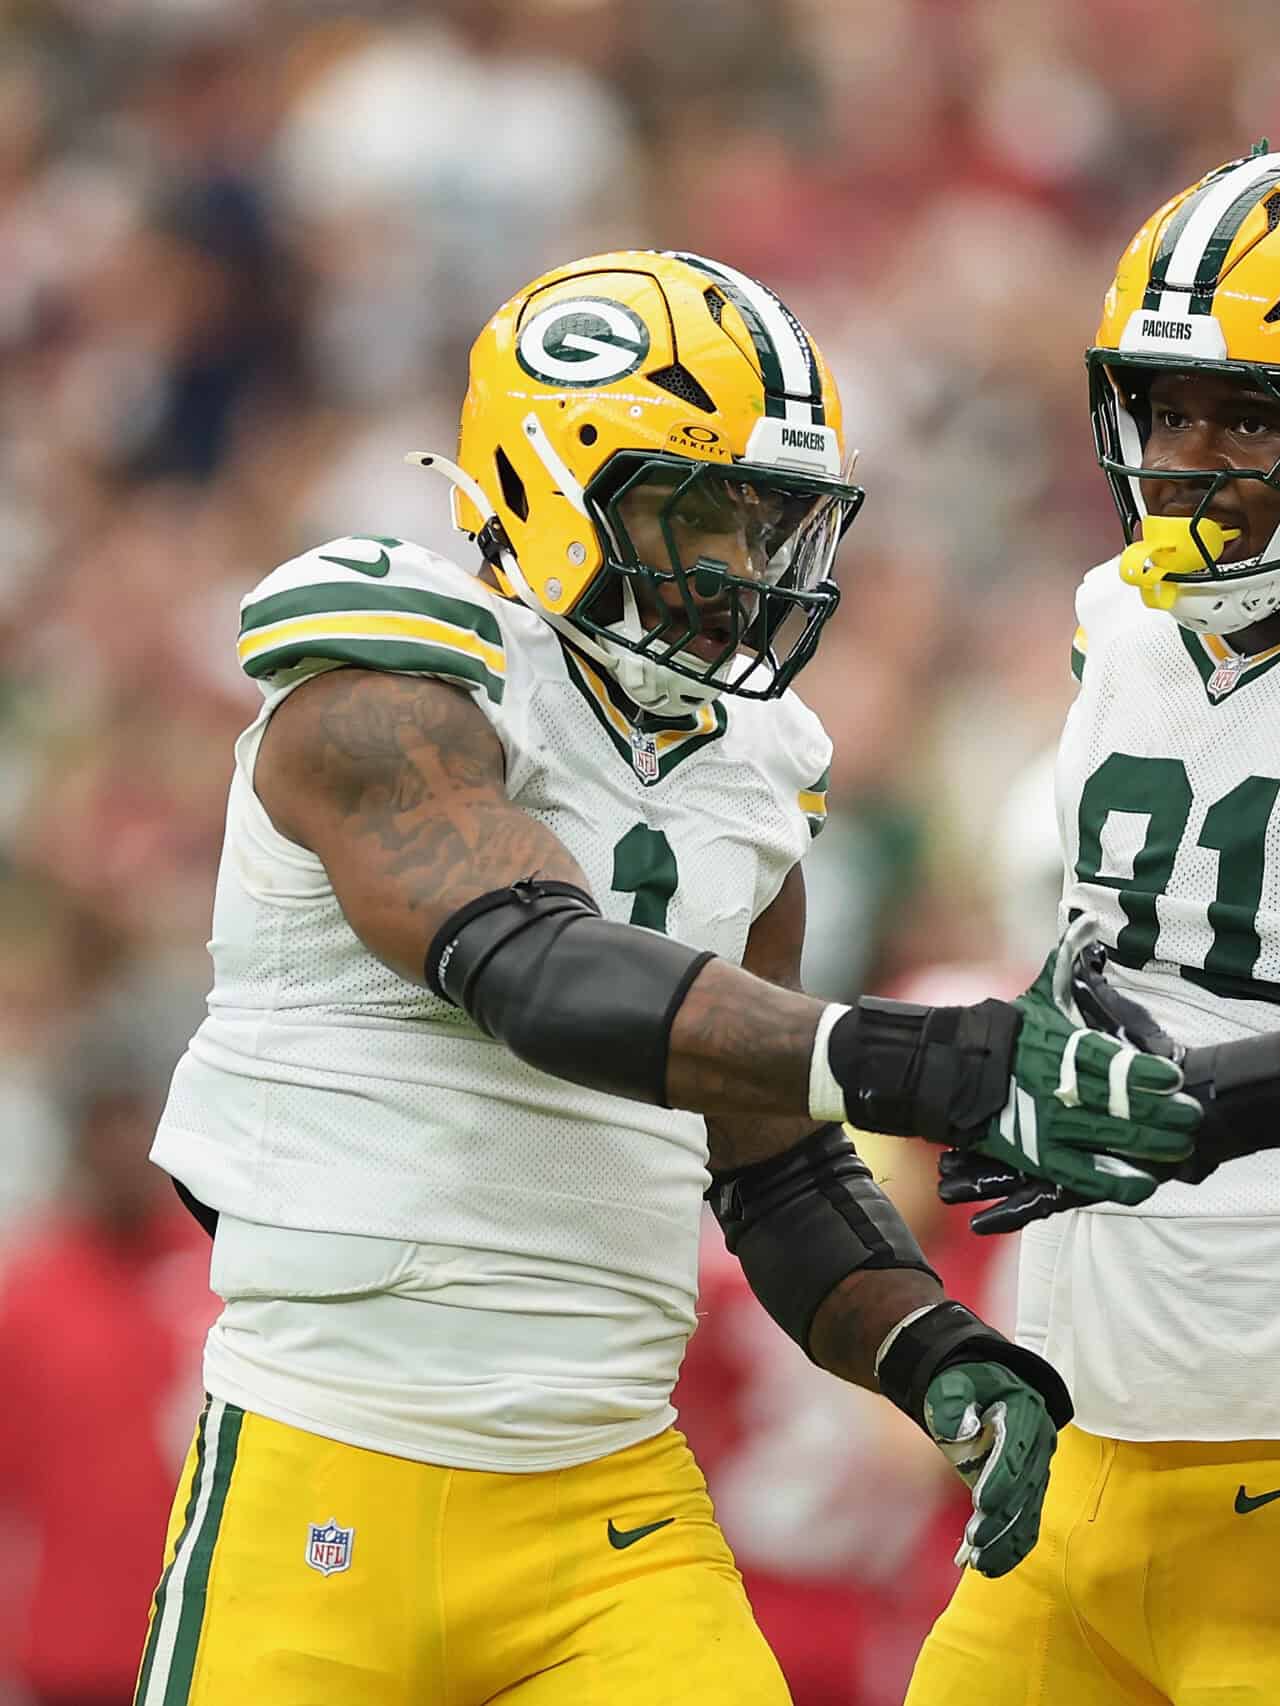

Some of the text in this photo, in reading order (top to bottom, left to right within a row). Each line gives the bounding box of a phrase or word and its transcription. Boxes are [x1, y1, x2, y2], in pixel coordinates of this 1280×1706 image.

[1142, 319, 1192, 340] PACKERS
[669, 435, 727, 456] OAKLEY
[781, 428, 825, 451] PACKERS
[611, 821, 679, 935] 1
[314, 1543, 344, 1566] NFL
